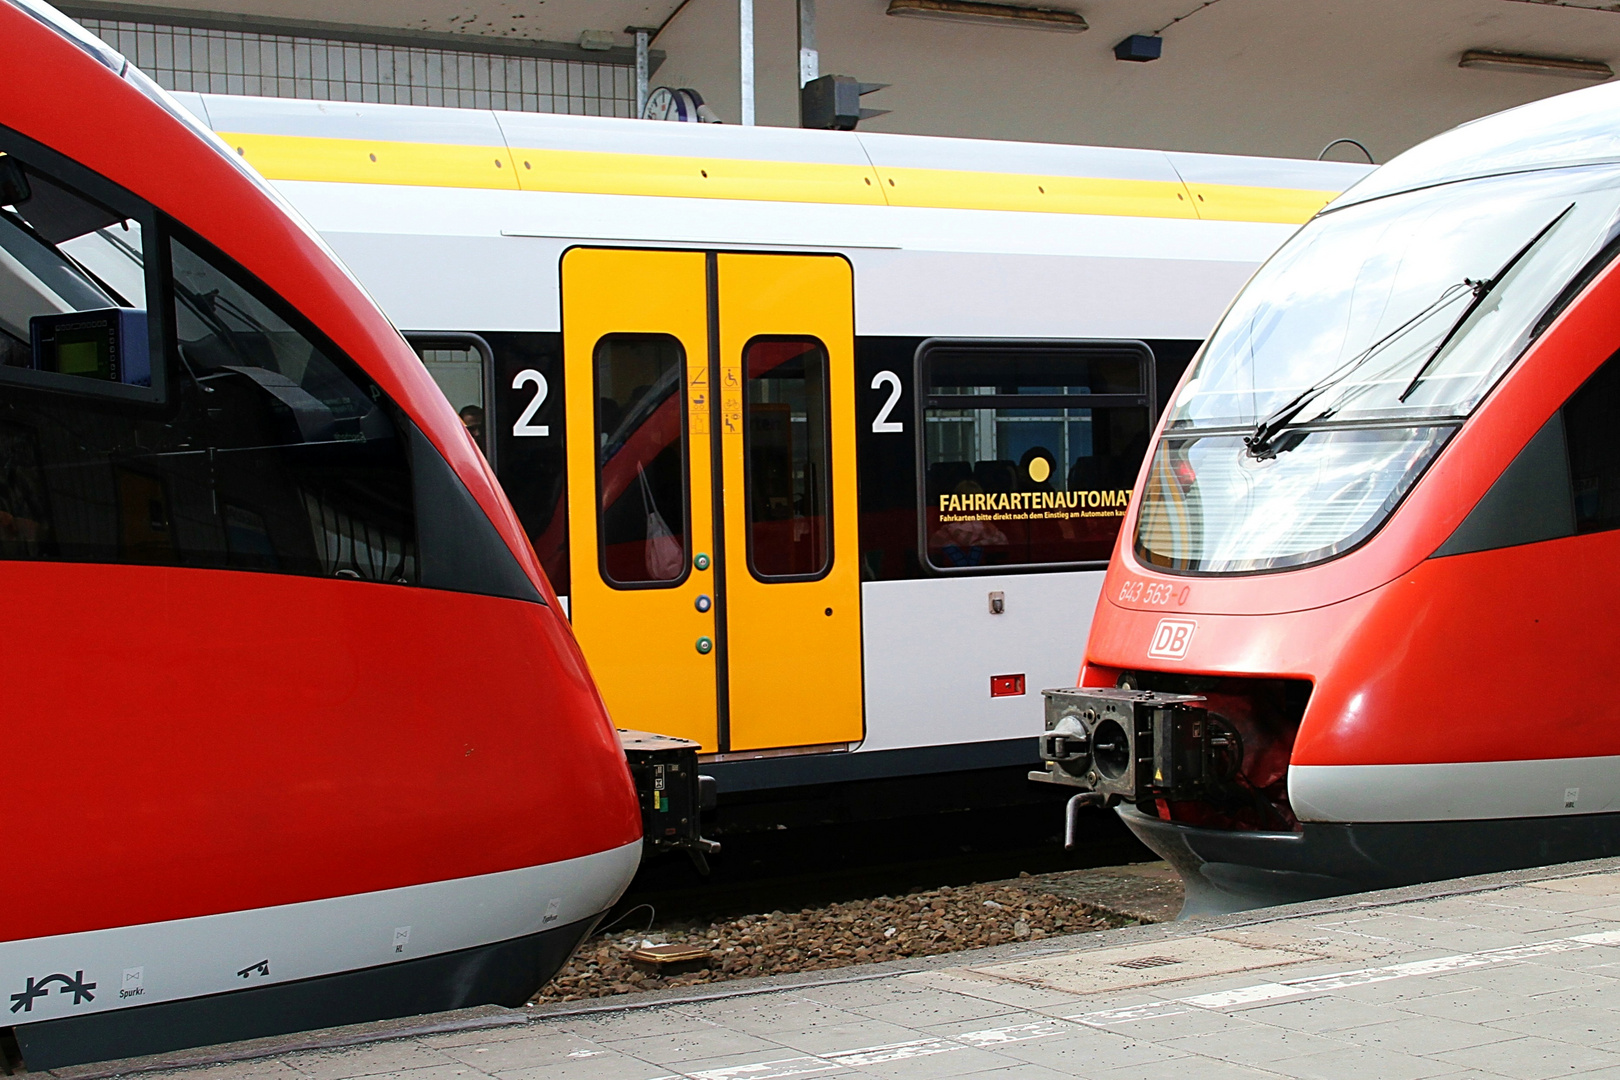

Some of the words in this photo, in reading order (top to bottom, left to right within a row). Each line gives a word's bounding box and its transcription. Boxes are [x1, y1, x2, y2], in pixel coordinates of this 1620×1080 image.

[512, 369, 549, 436] 2
[871, 370, 903, 433] 2
[940, 490, 1134, 512] FAHRKARTENAUTOMAT
[940, 514, 976, 522] Fahrkarten
[976, 513, 992, 521] bitte
[993, 512, 1012, 520] direkt
[1013, 512, 1028, 520] nach
[1029, 511, 1043, 519] dem
[1044, 510, 1069, 520] Einstieg
[1081, 510, 1114, 518] Automaten
[1119, 581, 1144, 602] 643
[1143, 583, 1191, 606] 563-0
[1155, 625, 1188, 652] DB
[119, 987, 146, 999] Spurkr.
